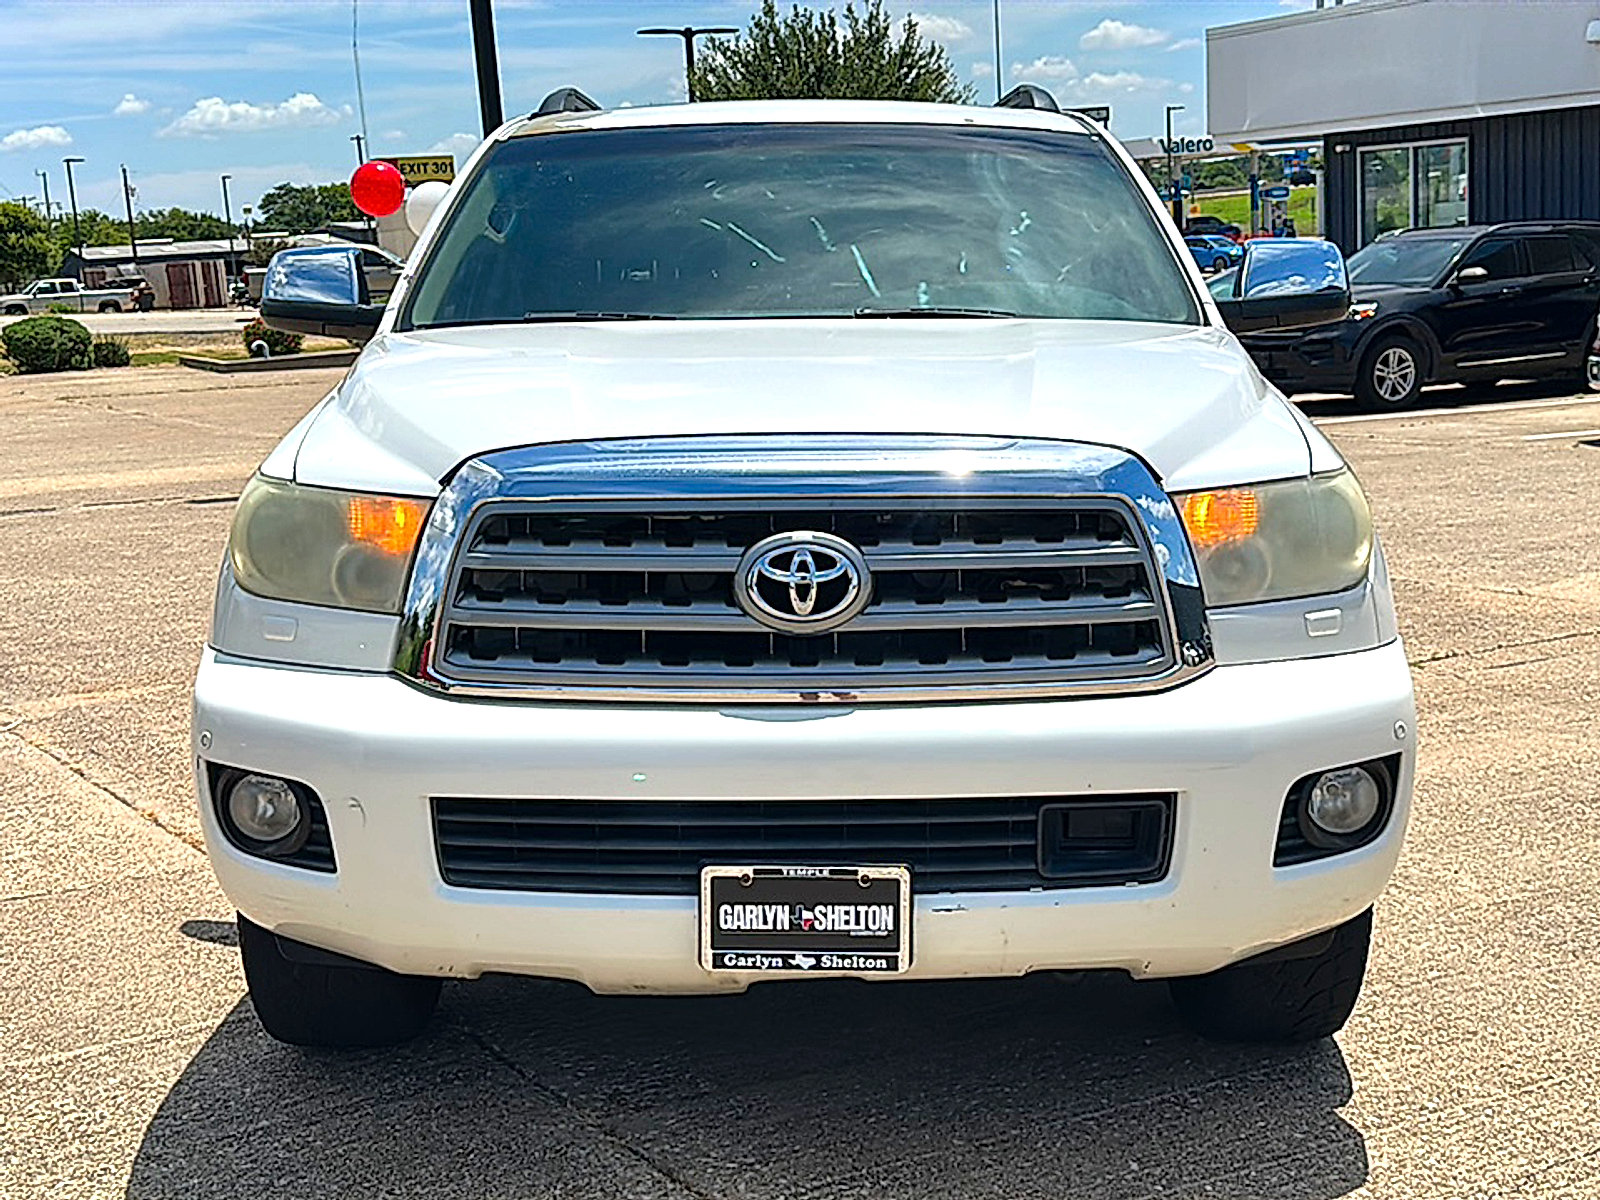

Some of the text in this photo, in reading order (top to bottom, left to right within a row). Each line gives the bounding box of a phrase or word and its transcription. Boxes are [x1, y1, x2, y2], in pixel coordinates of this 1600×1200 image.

[1160, 138, 1214, 153] Valero
[400, 162, 454, 174] EXIT 301
[782, 868, 829, 877] TEMPLE
[719, 904, 894, 931] GARLYN SHELTON
[723, 953, 888, 969] Garlyn Shelton
